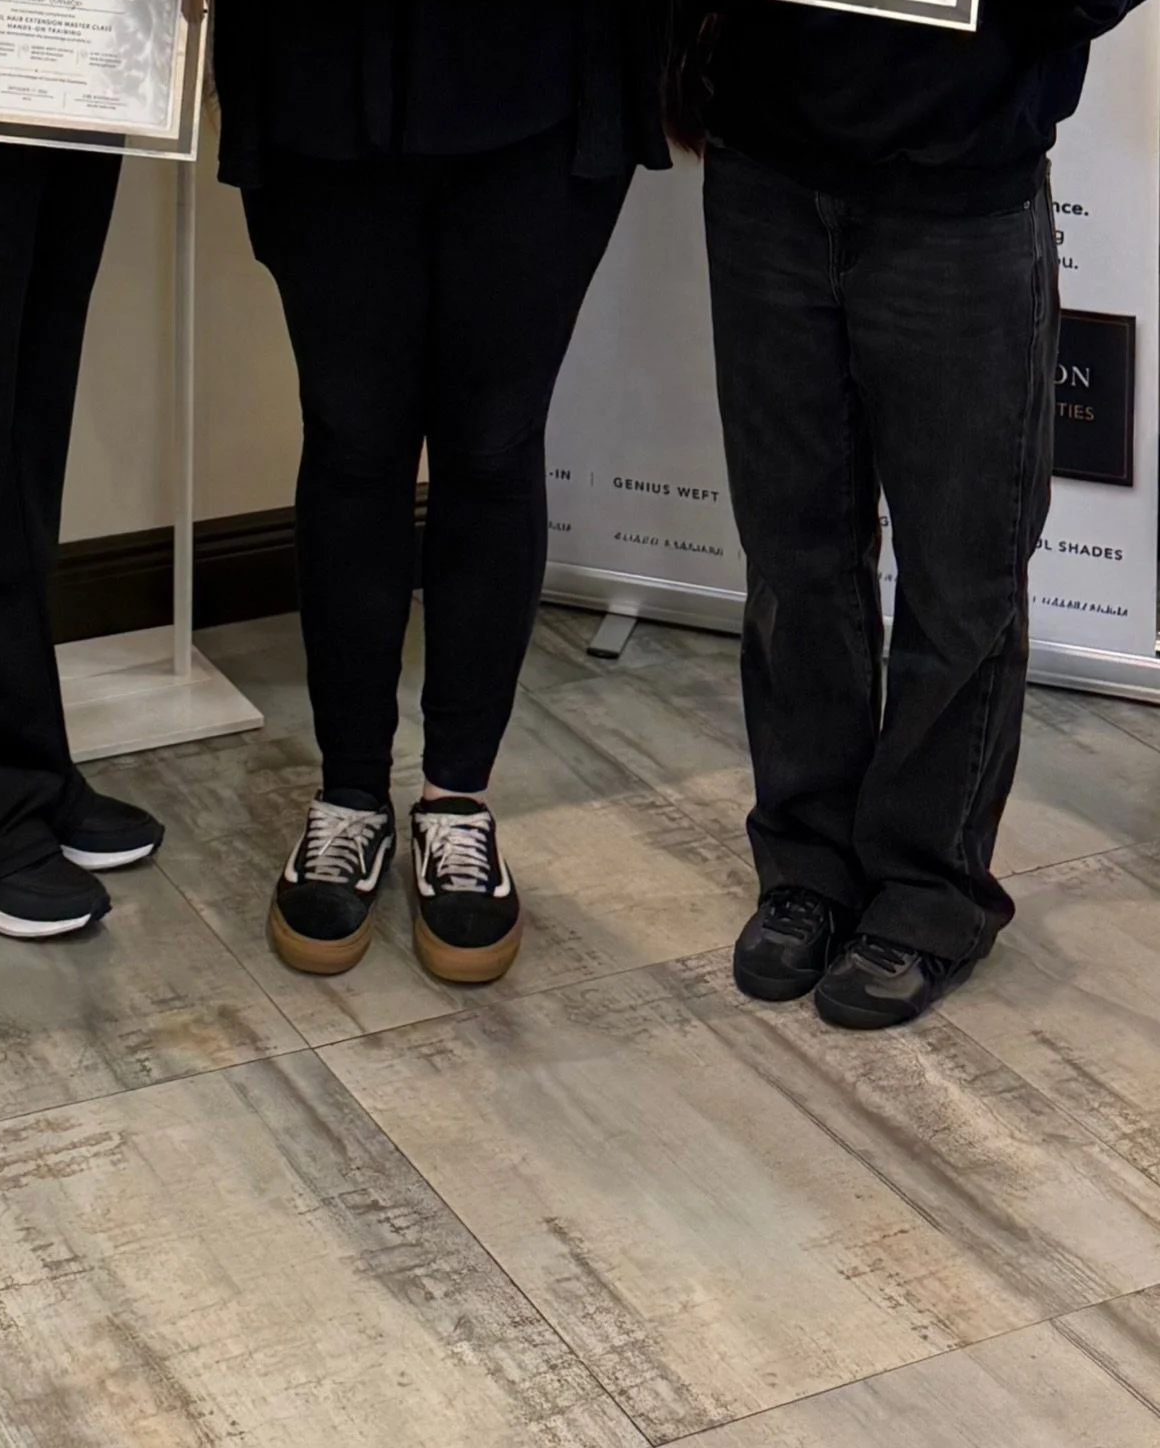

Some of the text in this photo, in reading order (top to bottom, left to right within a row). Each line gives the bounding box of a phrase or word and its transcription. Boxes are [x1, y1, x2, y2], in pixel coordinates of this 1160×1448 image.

[24, 17, 63, 27] EXTENSION
[613, 477, 720, 503] GENIUS WEFT
[1058, 540, 1124, 562] SHADES
